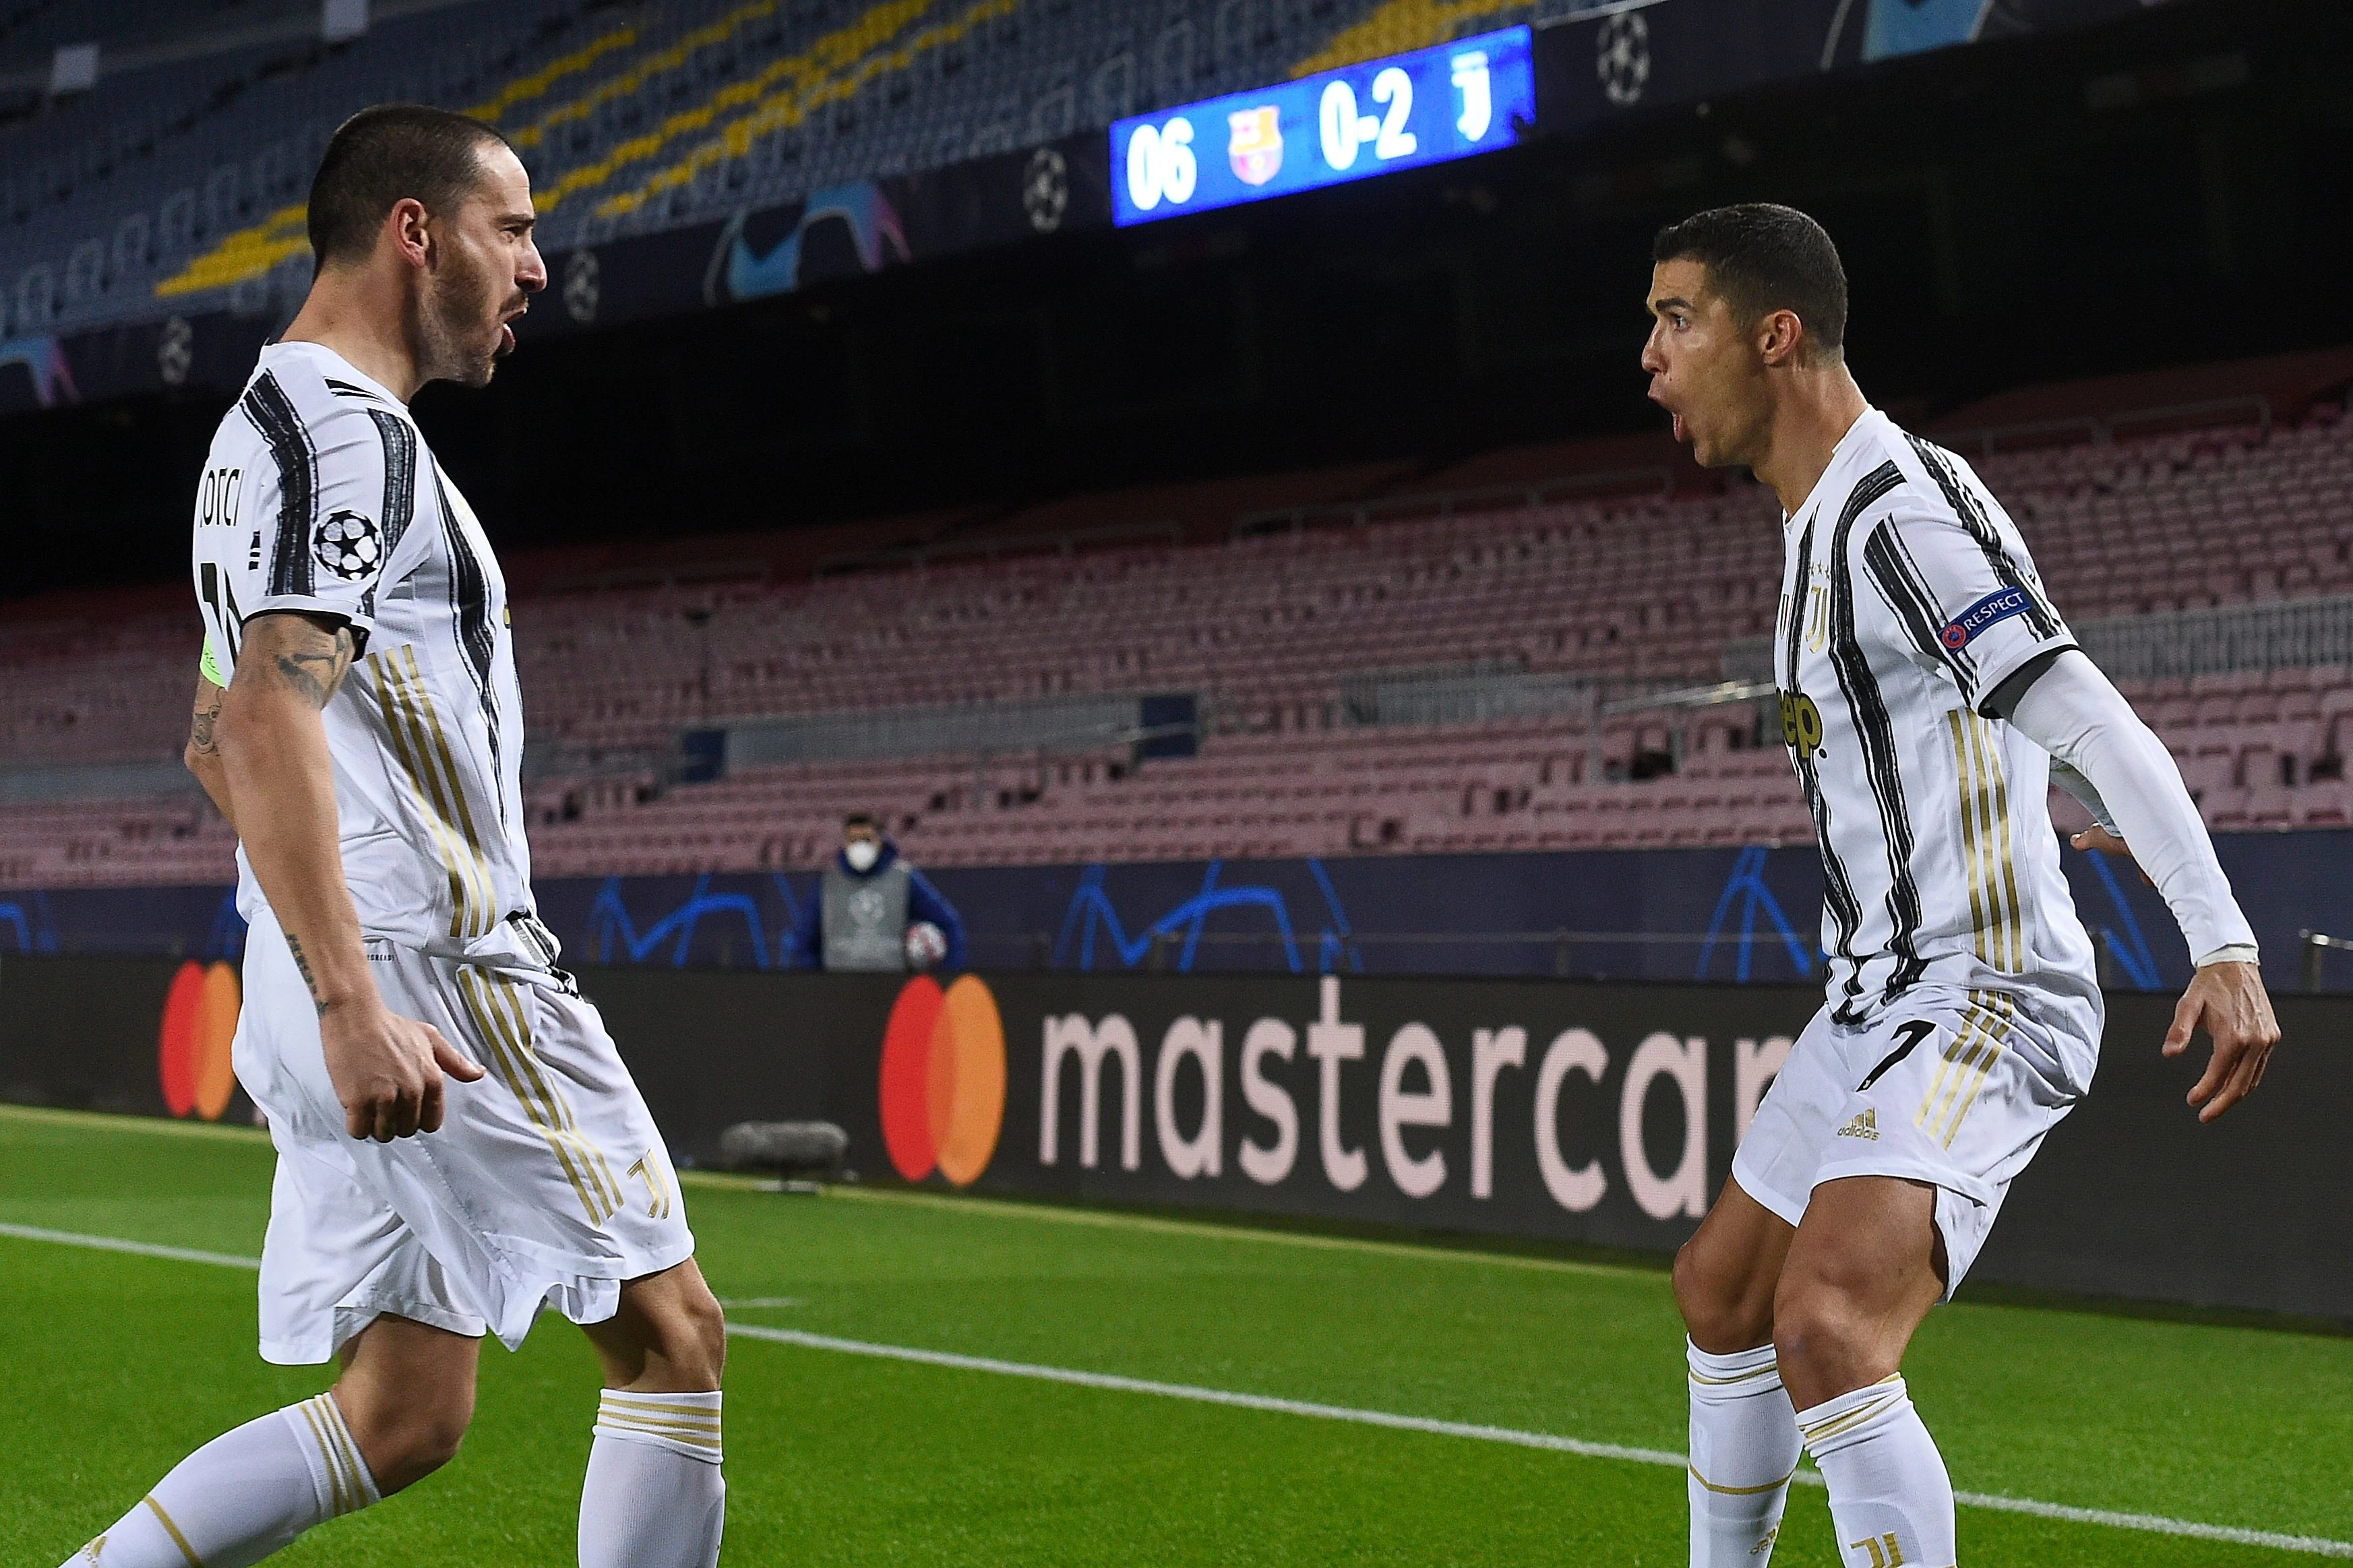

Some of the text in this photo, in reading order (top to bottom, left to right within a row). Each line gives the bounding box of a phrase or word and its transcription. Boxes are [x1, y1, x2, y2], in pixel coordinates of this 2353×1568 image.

[1127, 117, 1196, 210] 06
[1319, 67, 1417, 170] 0-2
[1963, 592, 2023, 631] RESPECT
[1856, 1019, 1936, 1092] 7
[1837, 1124, 1880, 1141] adidas
